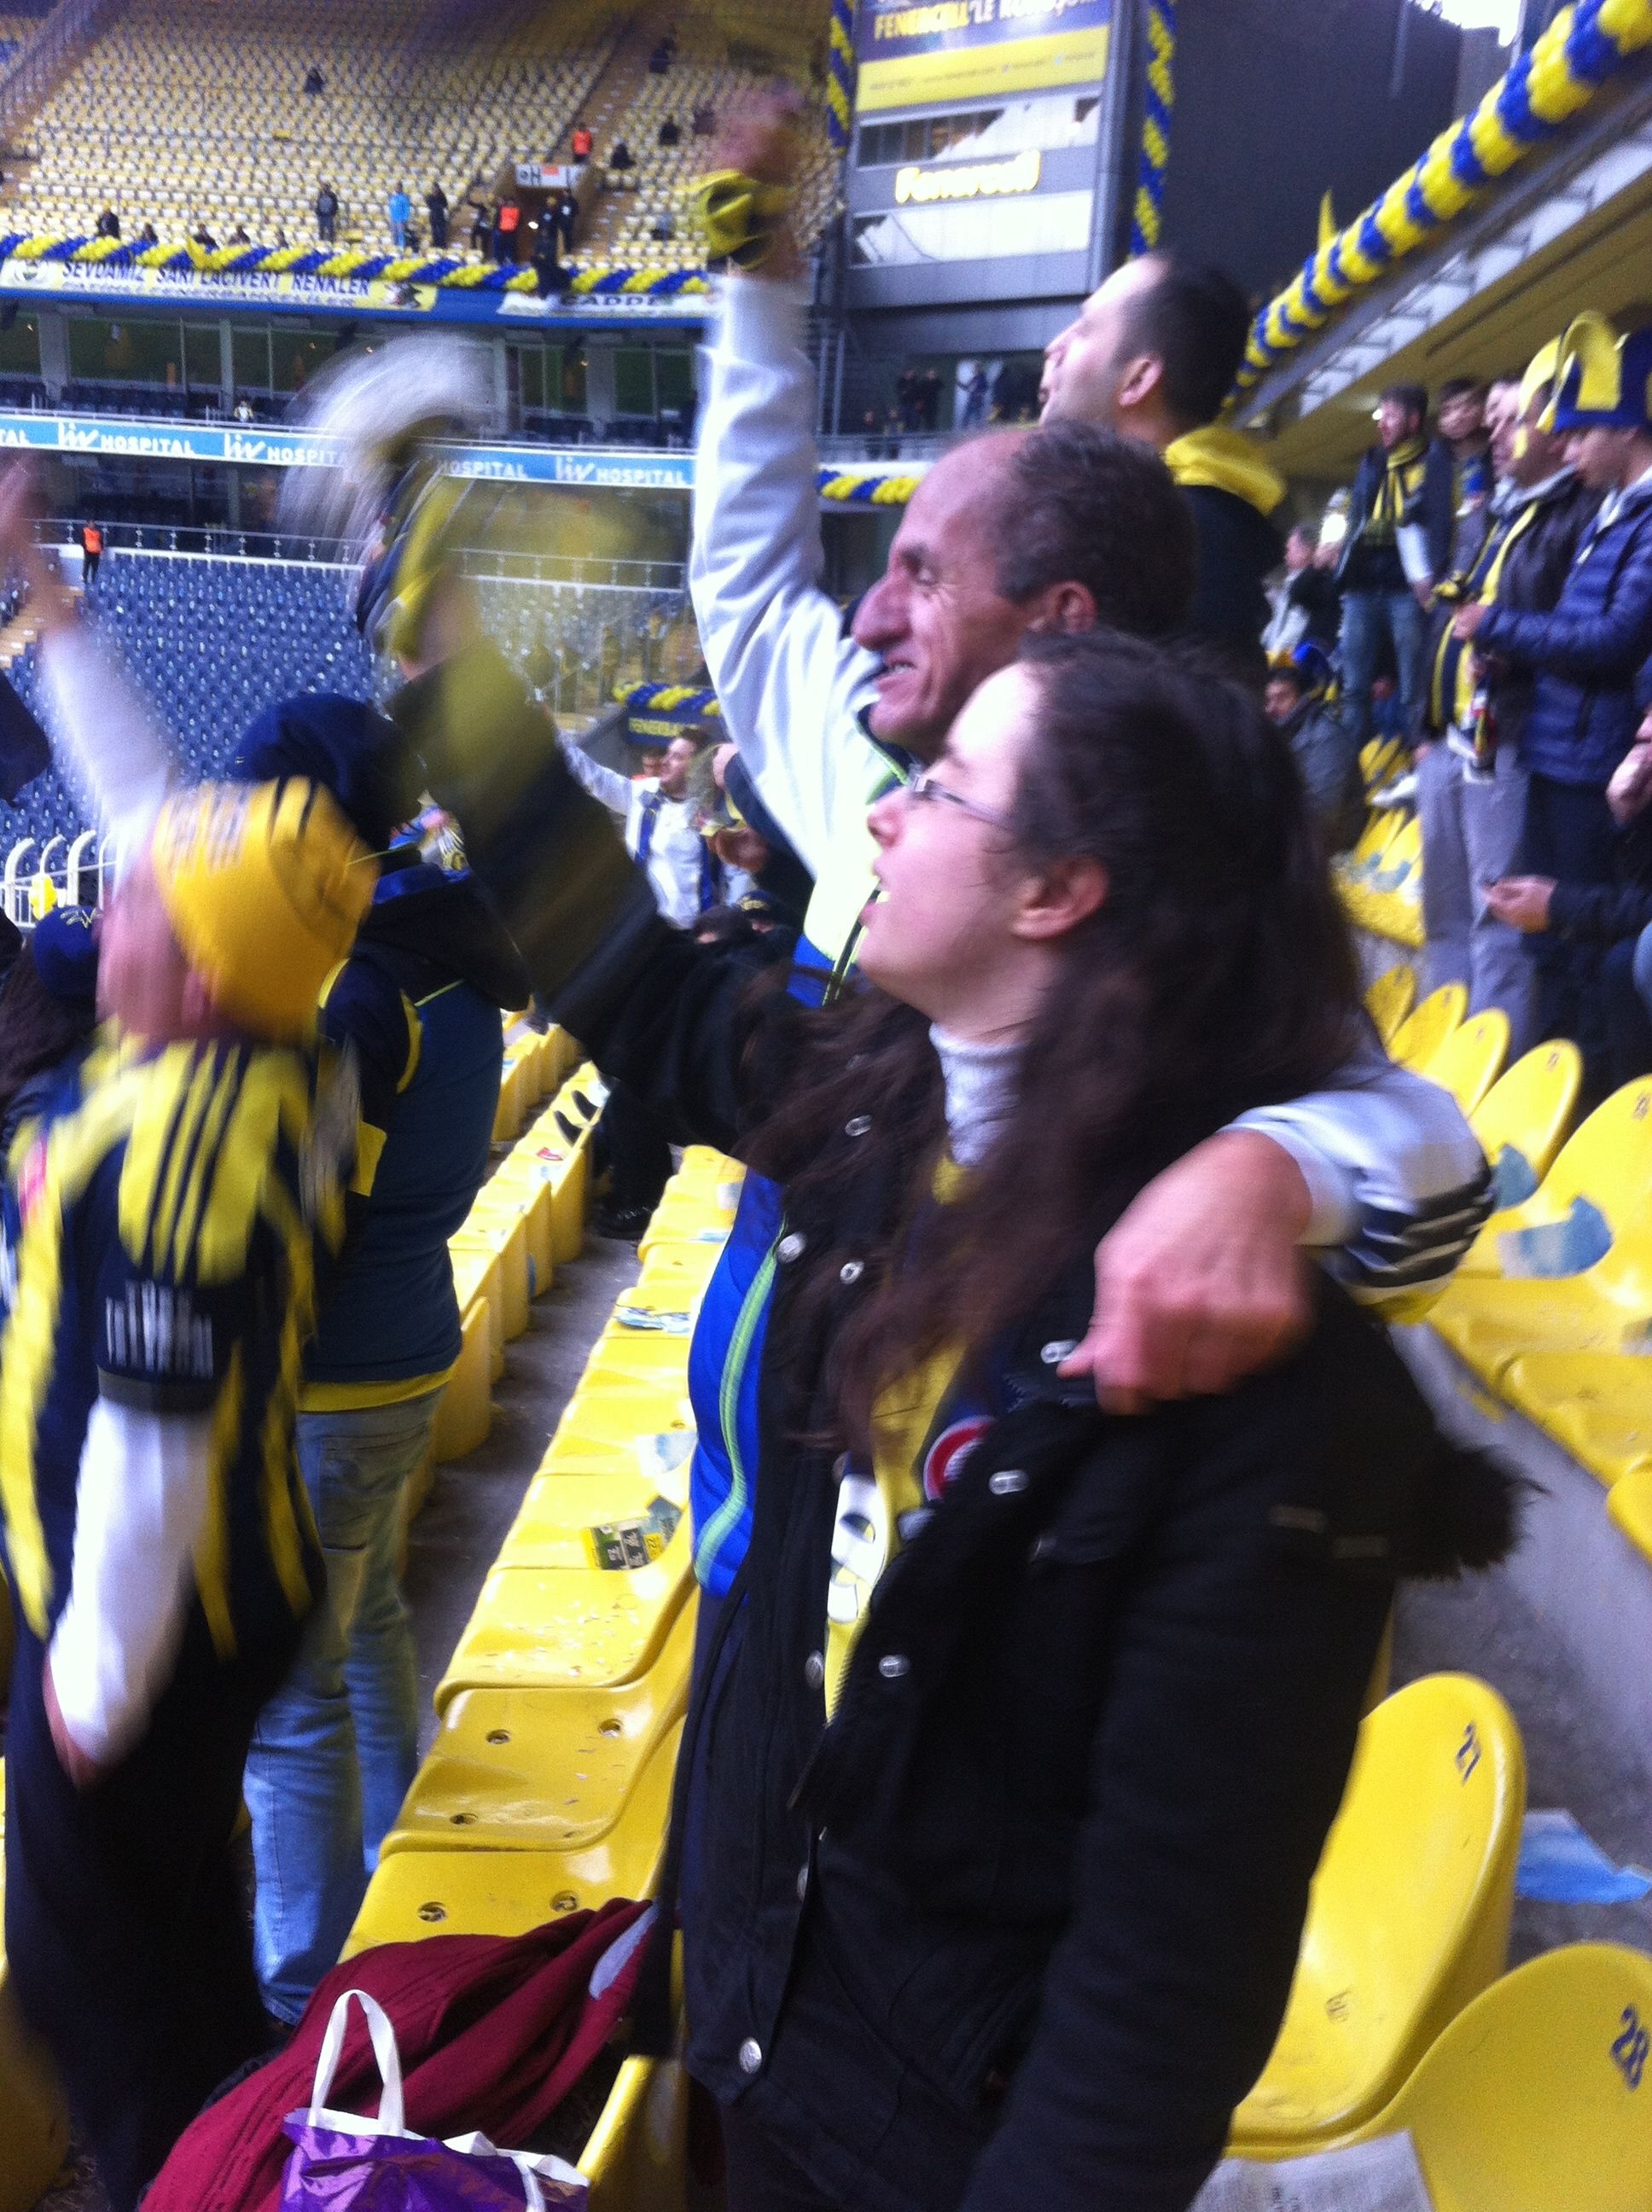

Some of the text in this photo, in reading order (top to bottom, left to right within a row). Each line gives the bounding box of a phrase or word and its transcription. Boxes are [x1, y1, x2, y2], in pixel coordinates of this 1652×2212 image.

[101, 434, 198, 456] HOSPITAL
[597, 469, 688, 486] HOSPITAL
[1611, 2002, 1649, 2093] 28
